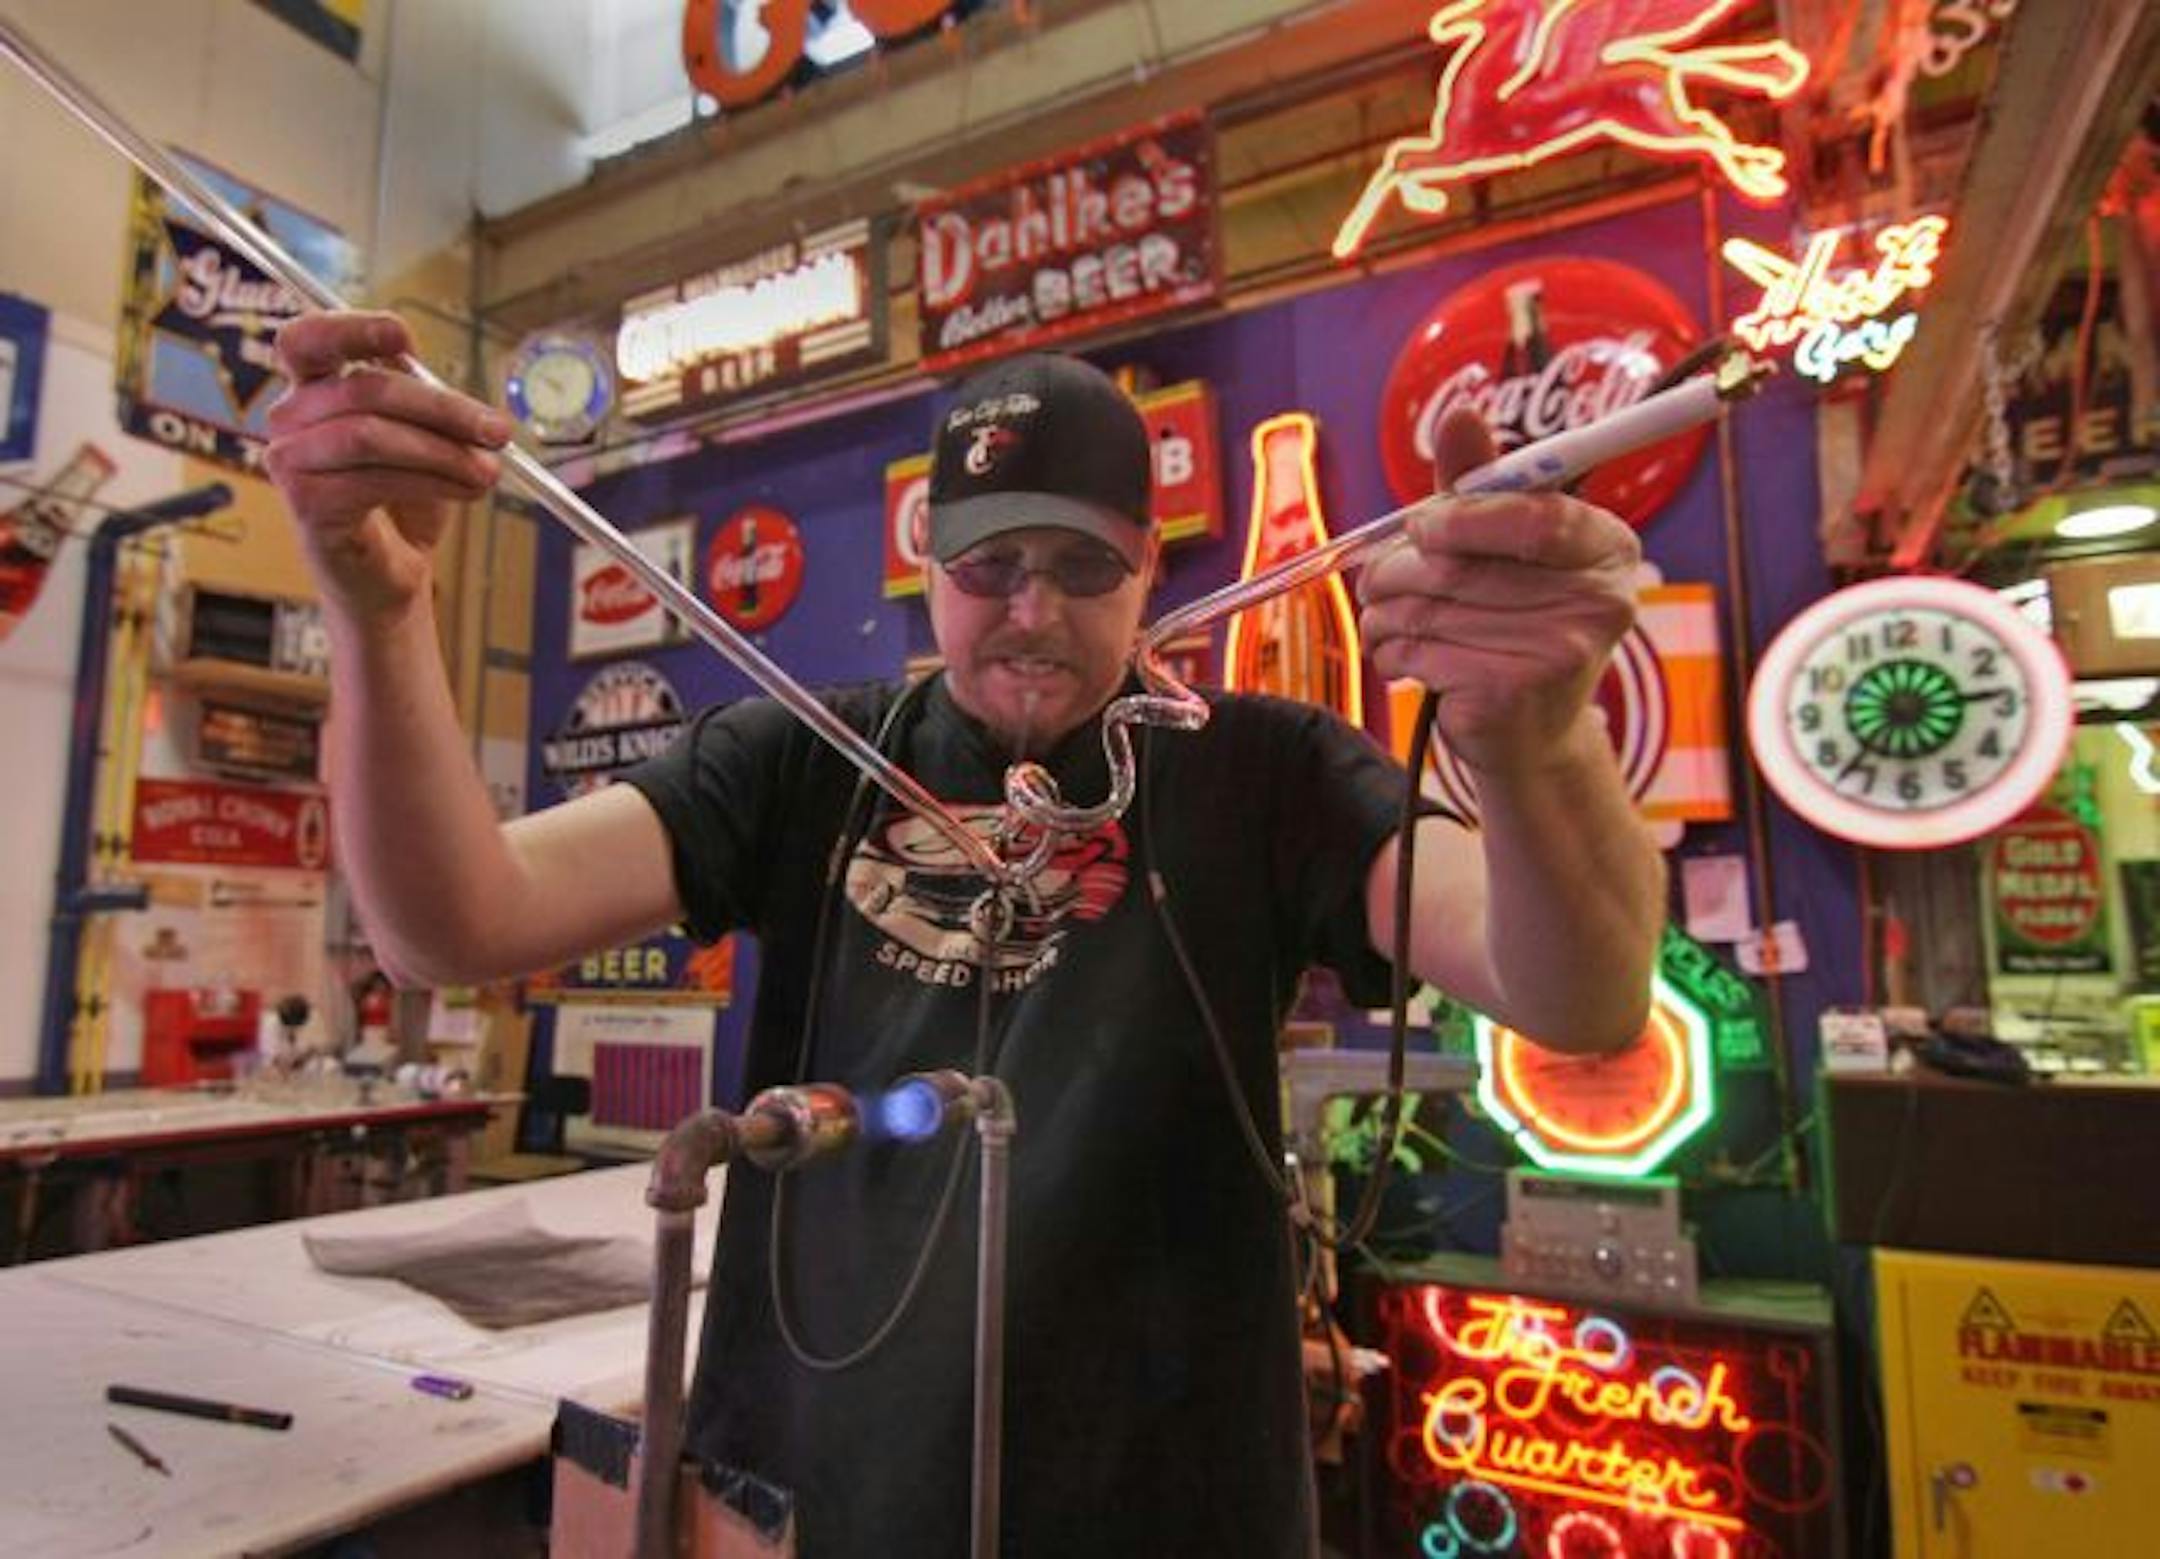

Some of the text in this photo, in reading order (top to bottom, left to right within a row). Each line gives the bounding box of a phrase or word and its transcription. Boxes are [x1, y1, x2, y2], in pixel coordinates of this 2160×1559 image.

[1033, 233, 1186, 320] BEER
[150, 412, 217, 454] ON
[1847, 633, 1872, 662] 11
[1882, 620, 1918, 649] 12
[1971, 647, 1997, 677] 2
[1810, 664, 1844, 694] 10
[1799, 702, 1822, 732] 9
[1993, 687, 2017, 718] 3
[1817, 738, 1839, 768] 8
[1975, 728, 2000, 758] 4
[1896, 770, 1921, 802] 6
[1943, 760, 1967, 790] 5
[581, 947, 668, 982] BEER
[876, 942, 1059, 993] SPEED HOP
[1495, 1346, 1752, 1432] French
[1421, 1375, 1718, 1508] Quarter
